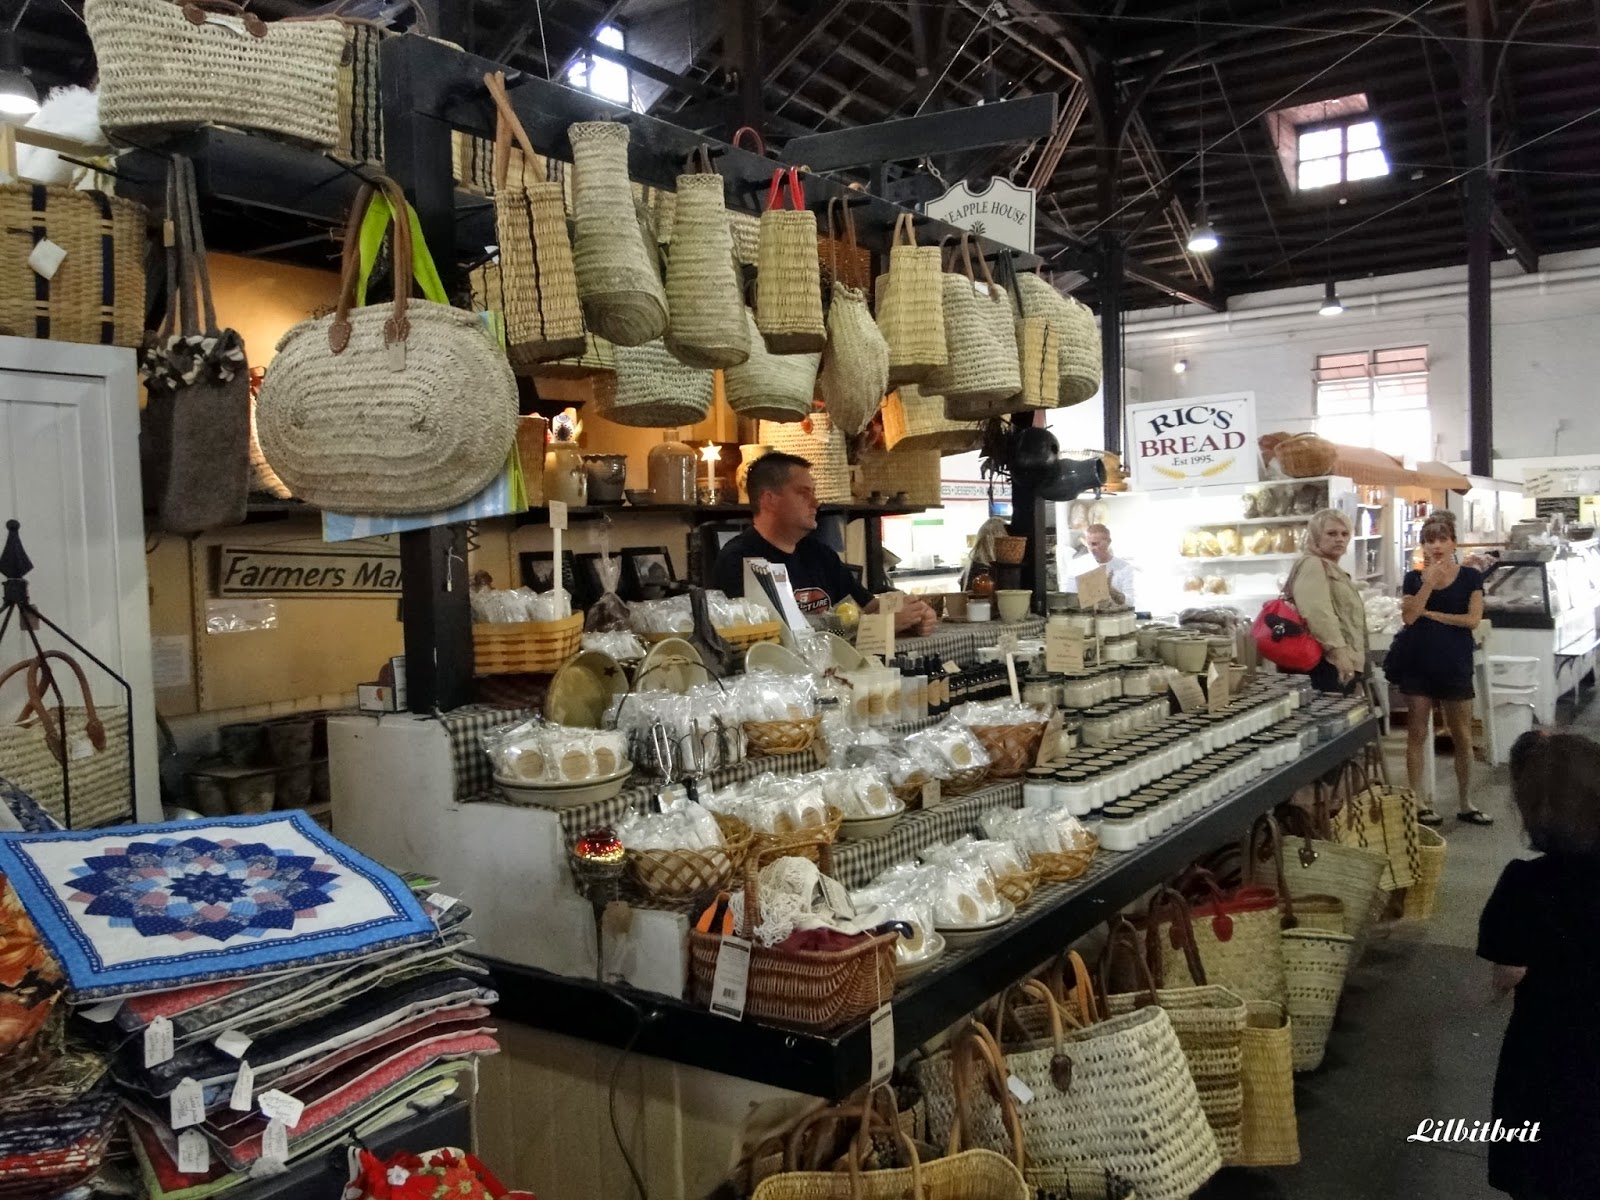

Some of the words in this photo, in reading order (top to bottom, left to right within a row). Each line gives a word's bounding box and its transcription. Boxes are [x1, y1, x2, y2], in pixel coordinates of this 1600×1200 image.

[944, 201, 988, 224] EAPPLE
[991, 202, 1027, 226] HOUSE
[1148, 405, 1233, 437] RIC'S
[1139, 431, 1246, 458] BREAD
[224, 556, 346, 587] Farmers
